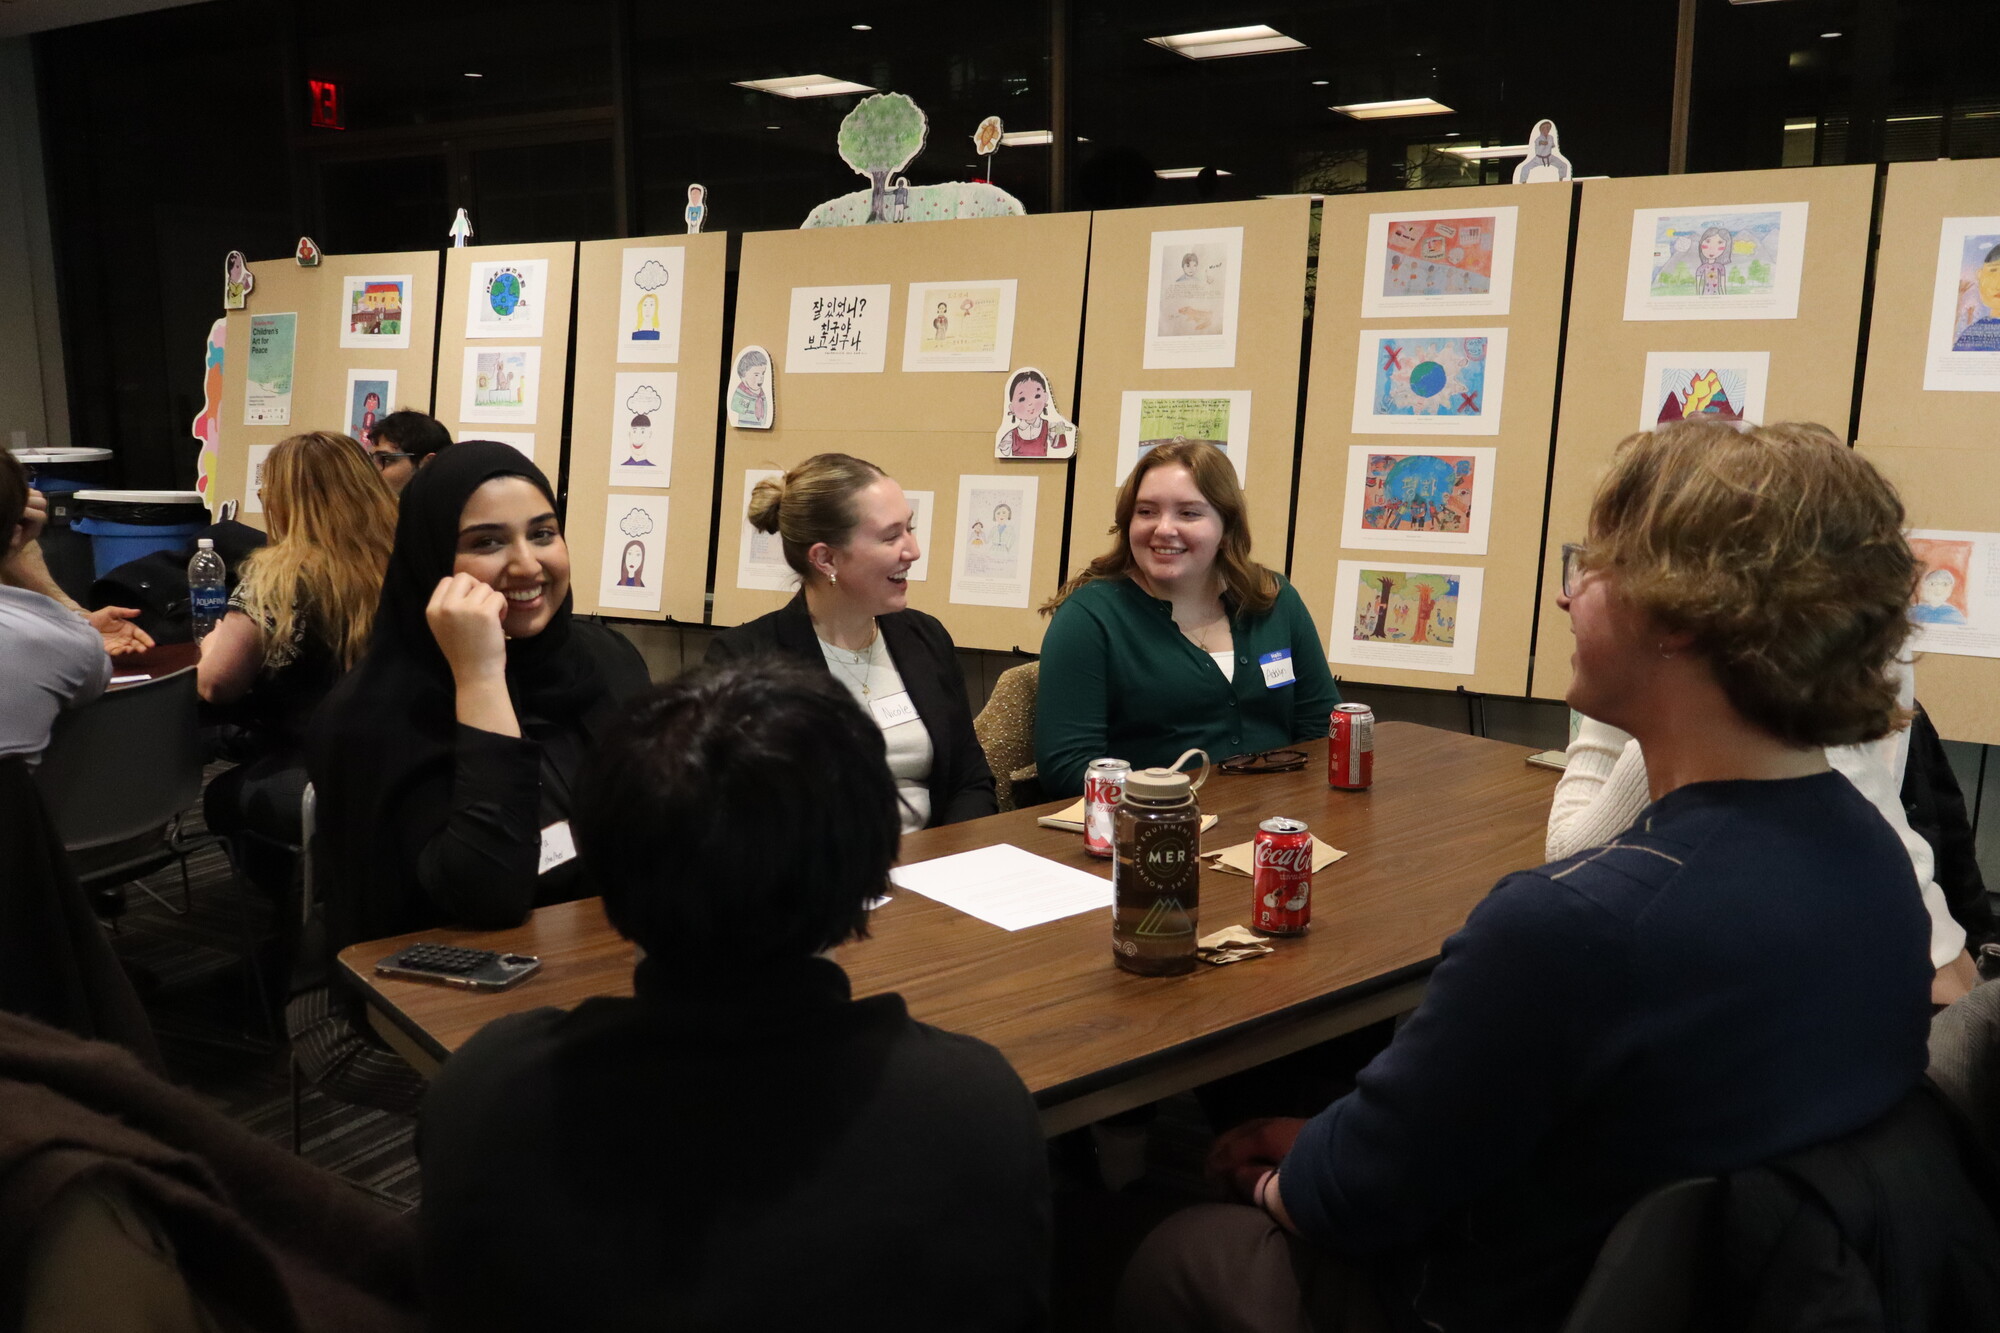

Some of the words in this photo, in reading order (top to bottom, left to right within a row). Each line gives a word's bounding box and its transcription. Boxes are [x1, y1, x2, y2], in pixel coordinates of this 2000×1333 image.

[252, 328, 279, 336] Children's
[821, 317, 852, 336] 친구야
[251, 346, 268, 354] Peace
[881, 703, 912, 720] Nicole
[1148, 850, 1186, 864] MER
